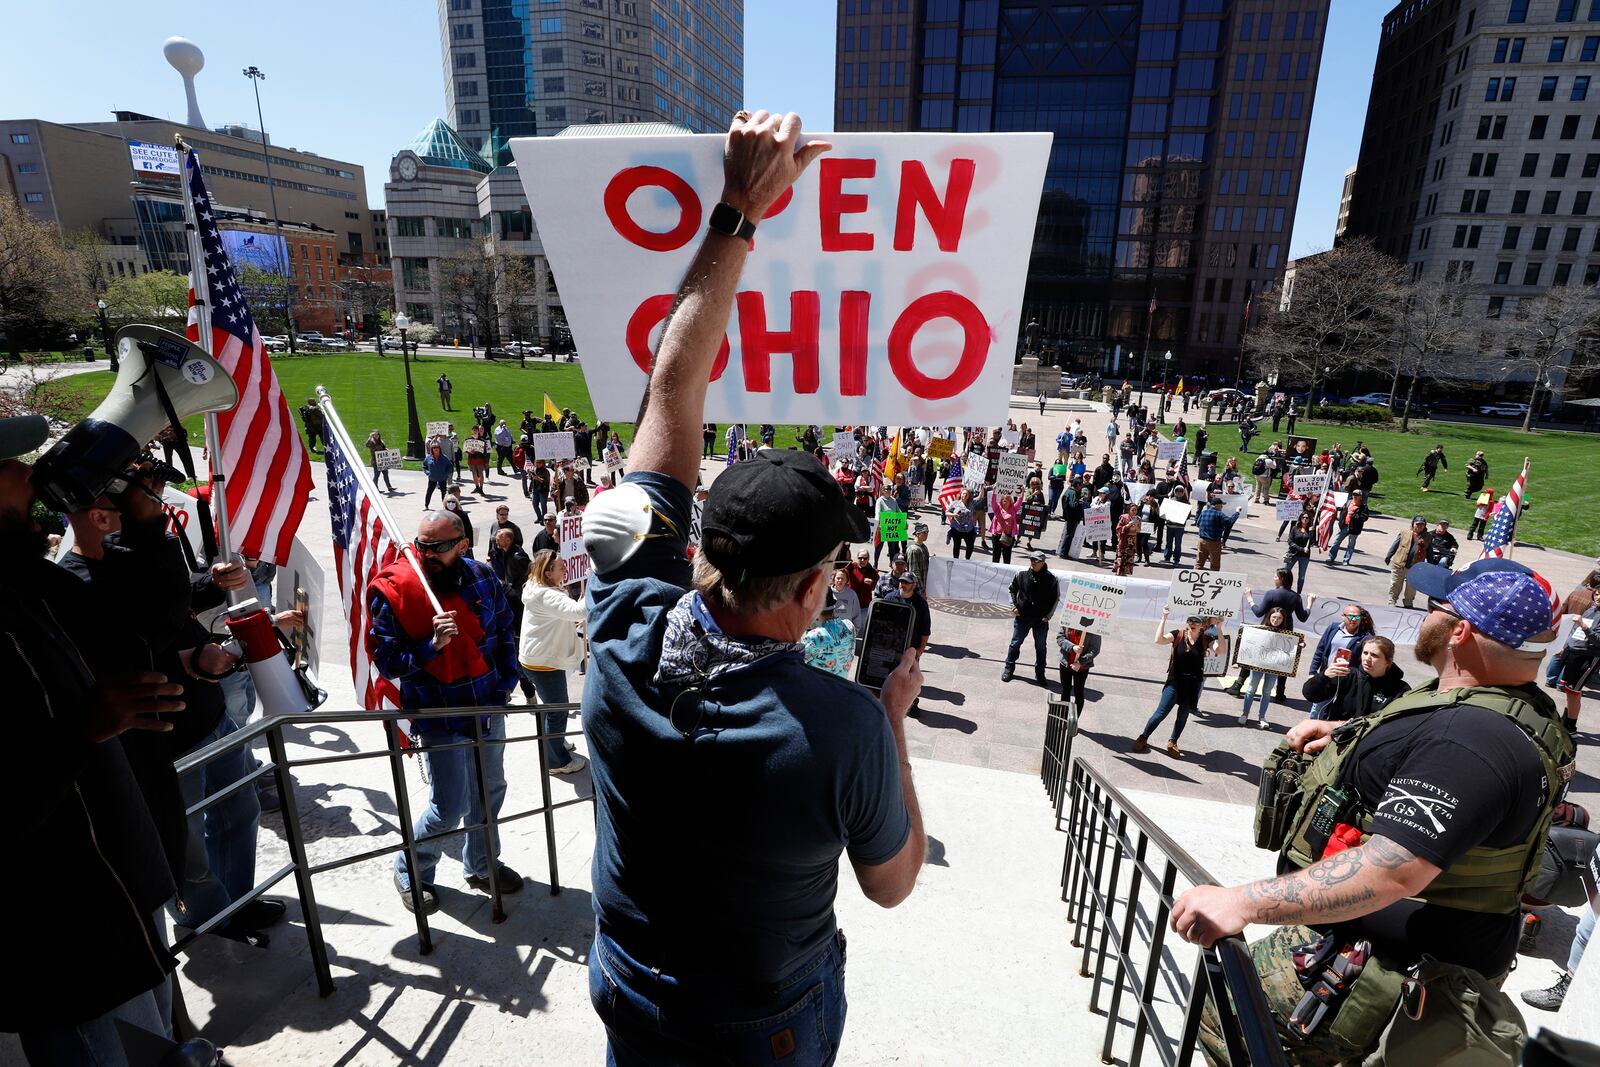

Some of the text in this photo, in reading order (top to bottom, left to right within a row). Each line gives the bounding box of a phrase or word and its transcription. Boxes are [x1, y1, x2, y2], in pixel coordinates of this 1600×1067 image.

[150, 150, 173, 158] CUTE
[603, 157, 976, 252] OEN
[626, 289, 991, 400] OHIO
[1001, 456, 1025, 466] MODELS
[571, 542, 577, 552] IS
[1178, 570, 1242, 587] CDC owns
[1068, 590, 1116, 609] SEND
[1190, 583, 1223, 600] 57
[1173, 596, 1207, 607] Vaccine
[1065, 603, 1112, 619] HEALTHY
[1390, 777, 1459, 806] GRUNT STYLE
[1393, 802, 1416, 817] GS
[1429, 802, 1453, 820] 1776
[1402, 818, 1438, 840] DEFEND
